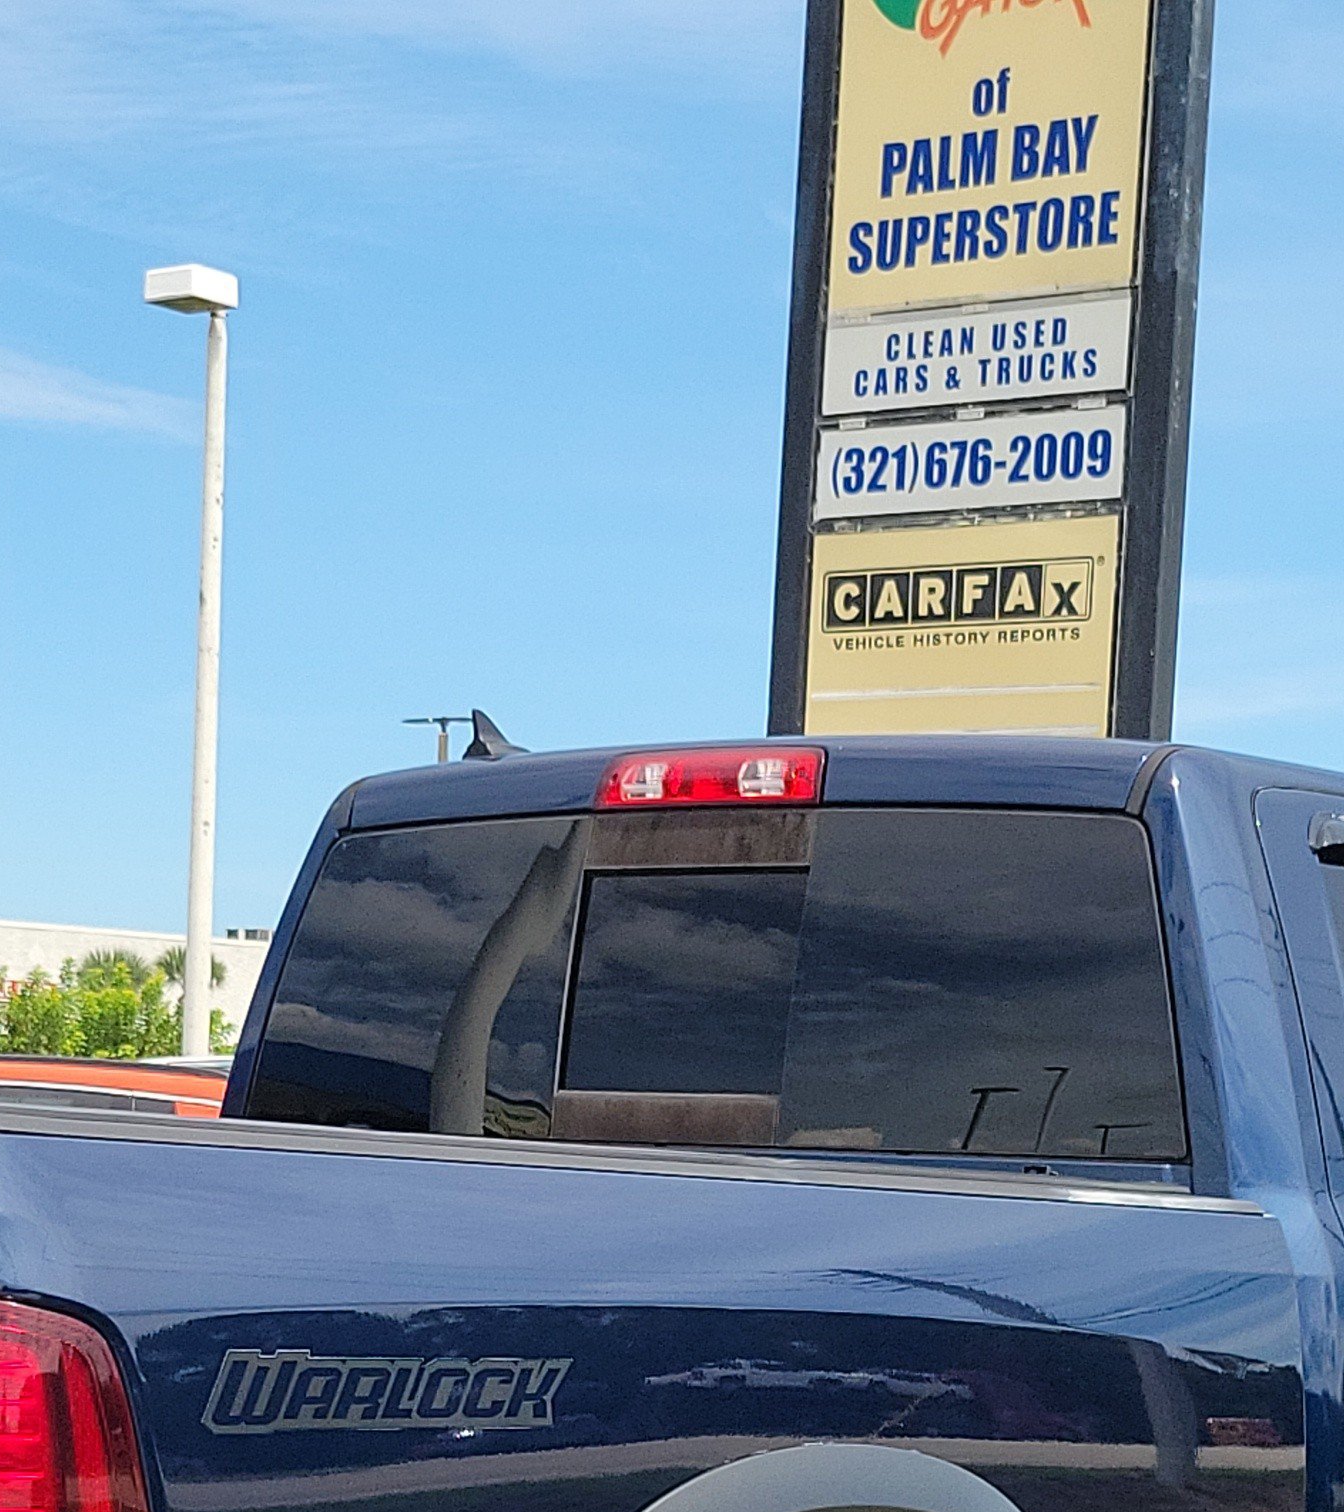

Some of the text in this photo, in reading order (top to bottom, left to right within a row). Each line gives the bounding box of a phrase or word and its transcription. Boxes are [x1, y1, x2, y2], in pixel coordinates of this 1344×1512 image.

[972, 67, 1011, 117] of
[880, 114, 1099, 199] PALM BAY
[847, 190, 1121, 275] SUPERSTORE
[885, 318, 1068, 362] CLEAN USED
[854, 348, 1098, 398] CARS & TRUCKS
[831, 429, 1113, 499] (321)676-2009
[832, 567, 1083, 623] CARFAX
[833, 627, 1081, 651] VEHICLE HISTORY REPORTS
[203, 1351, 571, 1433] WARLOCK
